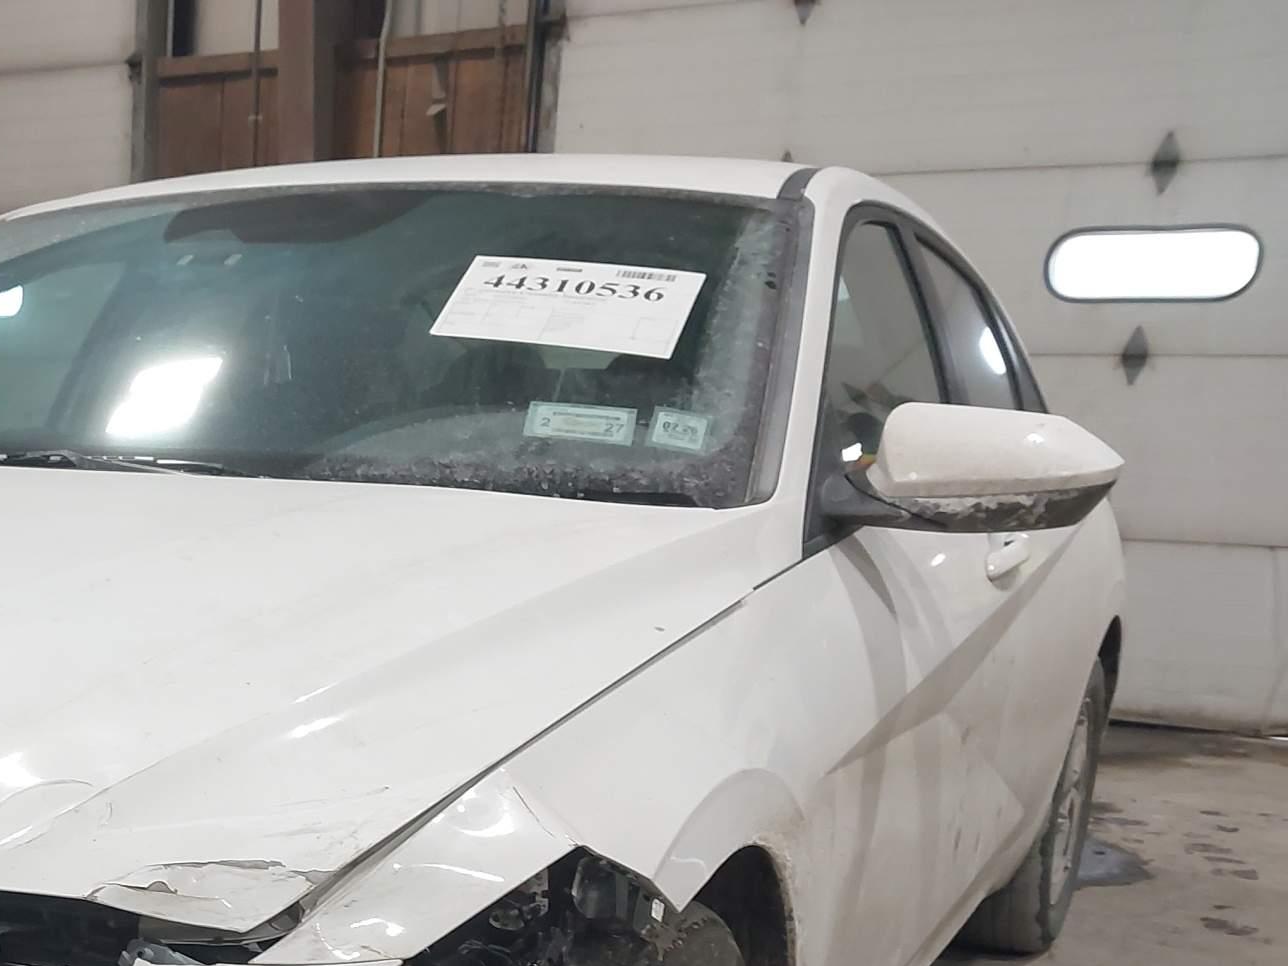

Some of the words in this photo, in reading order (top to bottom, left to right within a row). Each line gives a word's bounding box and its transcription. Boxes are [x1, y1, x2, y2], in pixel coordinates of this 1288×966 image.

[483, 274, 665, 301] 44310536
[540, 416, 551, 427] 2
[603, 422, 625, 433] 27
